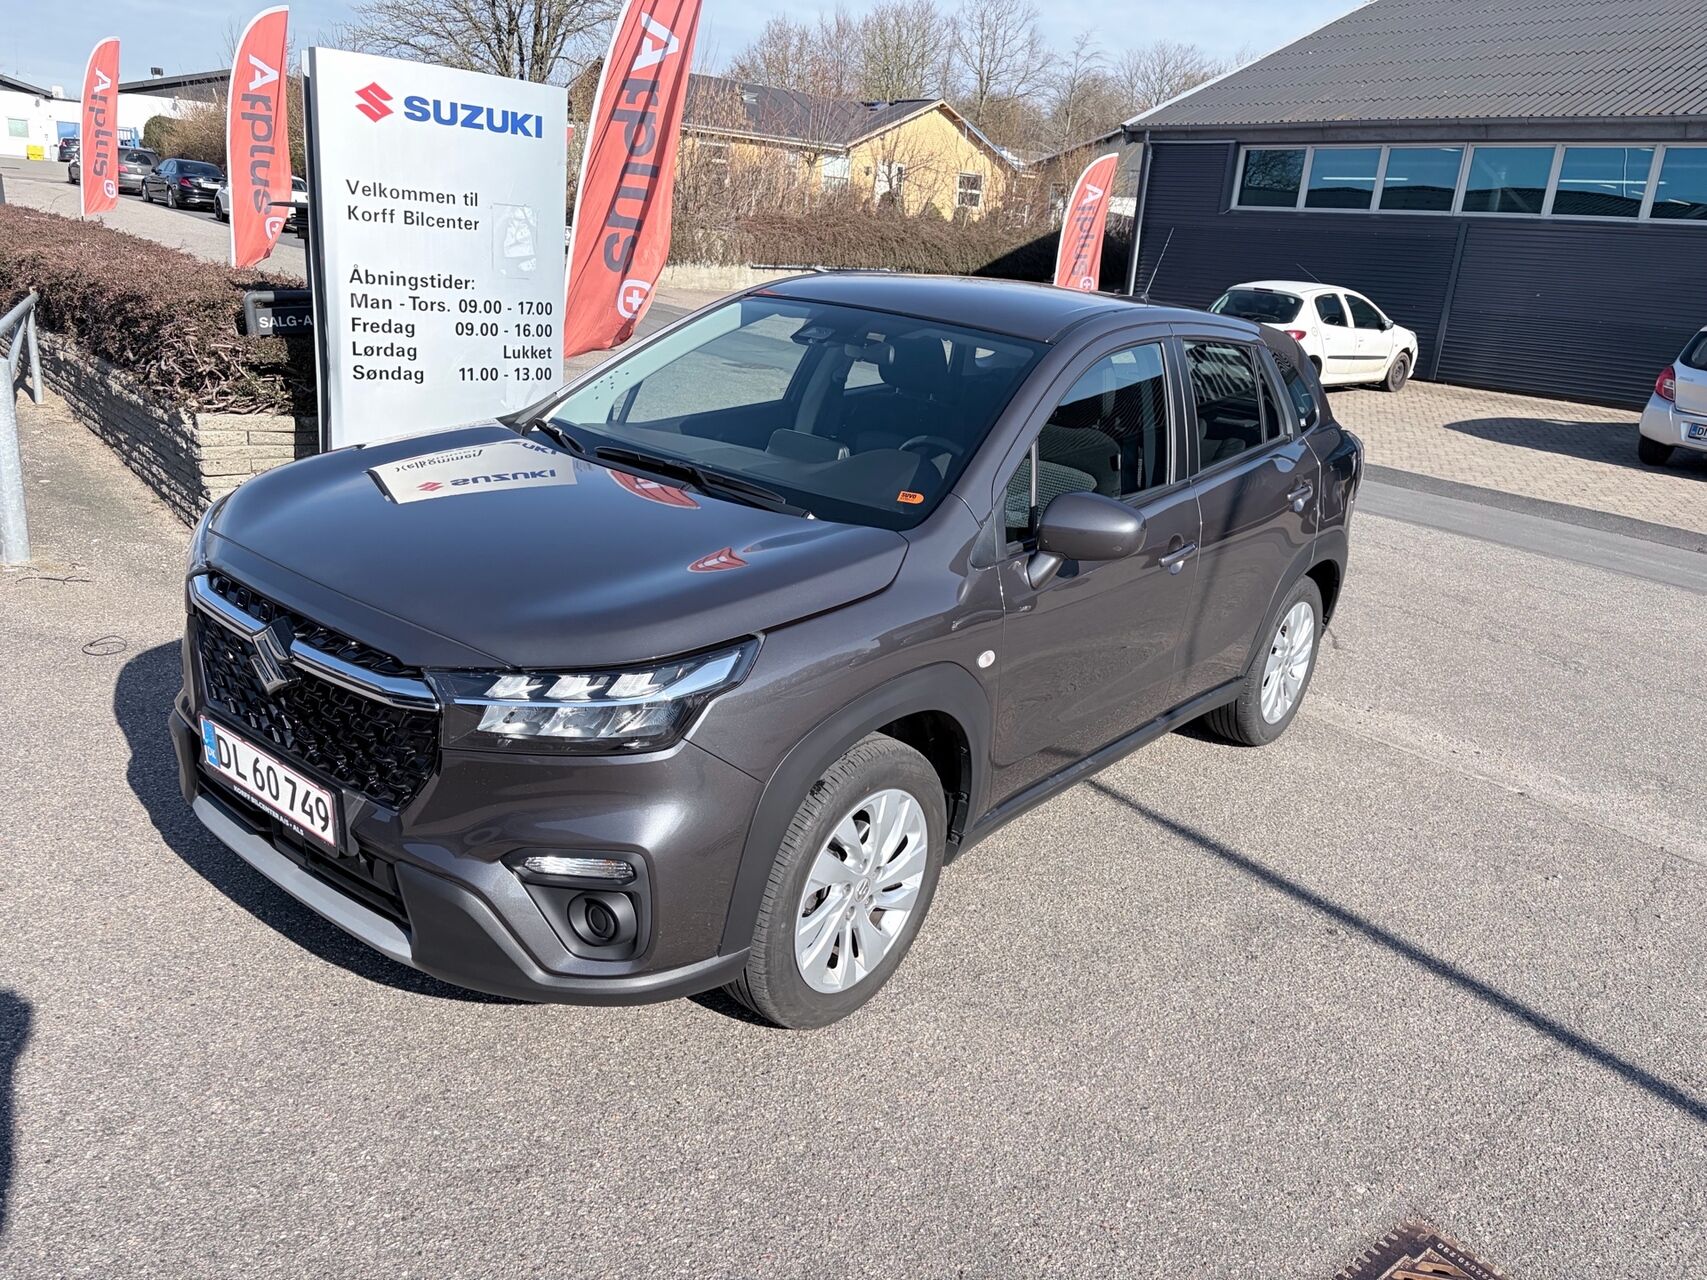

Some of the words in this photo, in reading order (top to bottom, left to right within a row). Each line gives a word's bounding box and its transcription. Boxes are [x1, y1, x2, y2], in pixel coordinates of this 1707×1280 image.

[88, 66, 112, 178] Arplus
[404, 95, 543, 139] SUZUKI
[240, 54, 279, 216] Arplus
[603, 11, 680, 274] Arplus
[345, 179, 456, 205] Velkommen
[463, 192, 478, 207] til
[347, 205, 397, 224] Korff
[403, 210, 480, 231] Bilcenter
[349, 264, 475, 290] Åbningstider:
[350, 293, 393, 310] Man
[408, 296, 450, 312] Tors.
[458, 299, 502, 315] 09.00
[518, 301, 553, 316] 17.00
[351, 317, 416, 337] Fredag
[455, 322, 498, 337] 09.00
[515, 323, 553, 338] 16.00
[352, 341, 417, 361] Lørdag
[503, 345, 552, 360] Lukket
[352, 365, 424, 384] Søndag
[459, 367, 498, 381] 11.00
[514, 367, 552, 381] 13.00
[217, 734, 248, 781] DL
[252, 757, 280, 802] 60
[284, 775, 330, 833] 749
